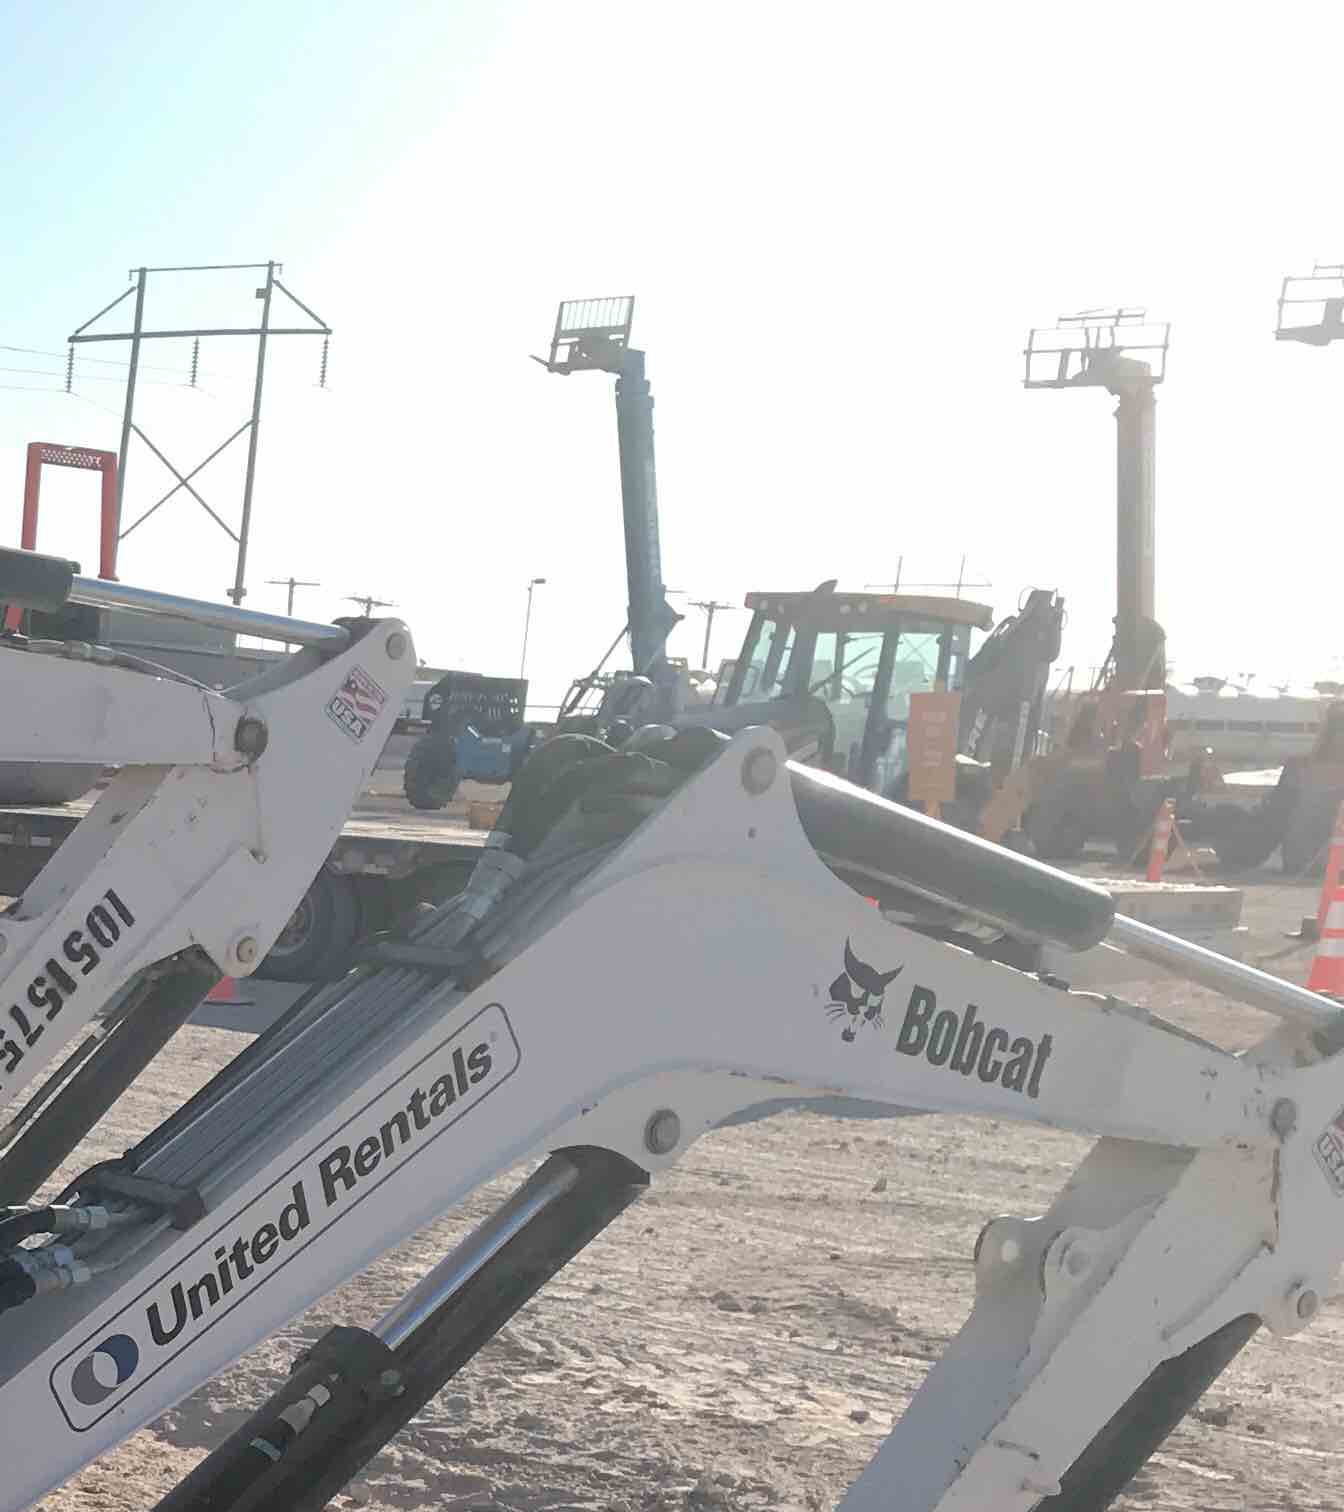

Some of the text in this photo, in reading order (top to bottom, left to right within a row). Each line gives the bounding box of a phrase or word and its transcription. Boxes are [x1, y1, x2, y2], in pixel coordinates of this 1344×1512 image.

[895, 984, 1054, 1099] Bobcat
[145, 1038, 494, 1346] United Rentals
